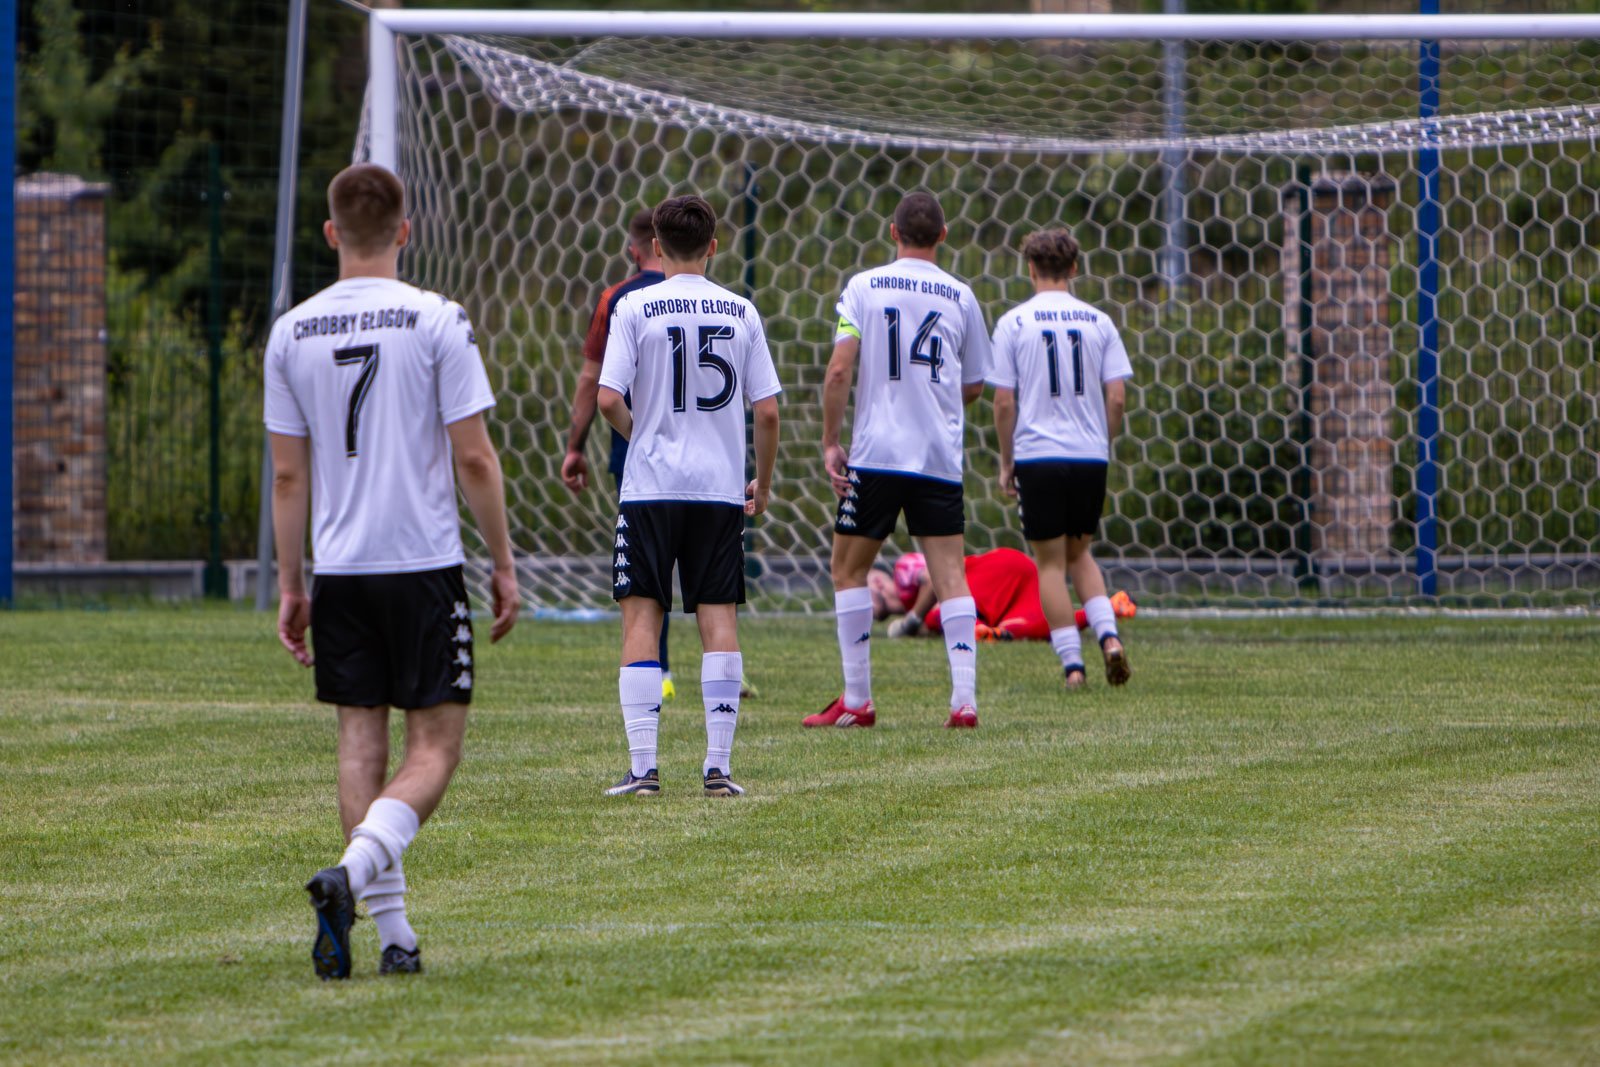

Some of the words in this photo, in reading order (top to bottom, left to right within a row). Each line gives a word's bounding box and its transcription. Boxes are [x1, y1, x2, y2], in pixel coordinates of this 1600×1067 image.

[643, 299, 697, 318] CHROBRY
[701, 299, 746, 319] GŁOGÓW
[870, 276, 918, 292] CHROBRY
[294, 314, 357, 340] CHROBRY
[360, 305, 420, 330] GŁOGÓW
[884, 307, 944, 383] 14
[666, 325, 737, 412] 15
[1041, 329, 1084, 397] 11
[333, 343, 380, 457] 7
